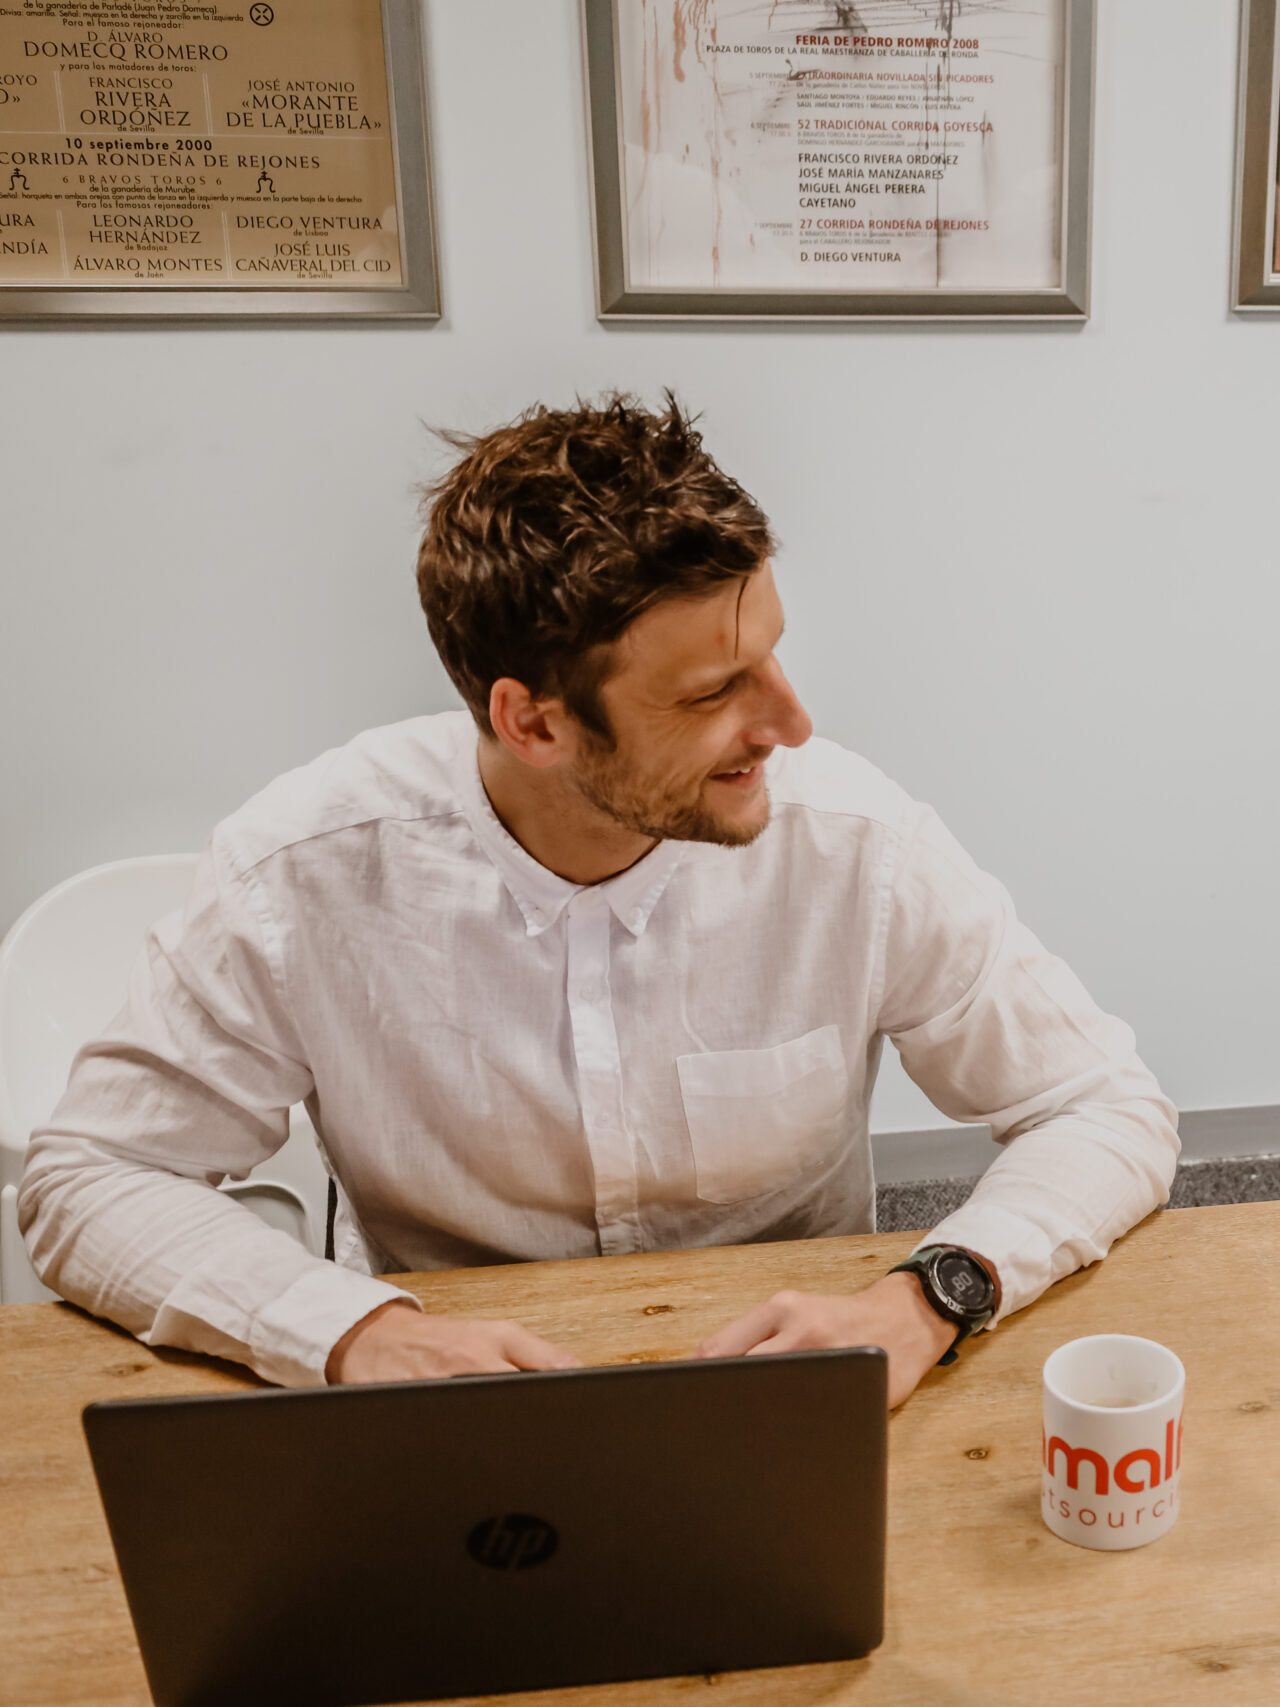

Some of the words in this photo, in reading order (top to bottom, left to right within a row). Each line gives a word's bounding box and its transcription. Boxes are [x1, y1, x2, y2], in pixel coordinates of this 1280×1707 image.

[23, 1, 33, 9] de
[36, 1, 43, 9] la
[90, 2, 100, 10] de
[158, 3, 180, 12] Pedro
[62, 18, 83, 27] Para
[87, 18, 95, 27] el
[98, 19, 130, 28] famoso
[108, 29, 163, 43] ÁLVARO
[796, 35, 830, 46] FERIA
[834, 35, 850, 47] DE
[853, 36, 893, 48] PEDRO
[897, 37, 949, 49] ROMERO
[952, 38, 980, 49] 2008
[24, 41, 128, 61] DOMECQ
[135, 43, 228, 61] ROMERO
[706, 45, 732, 54] PLAZA
[734, 45, 744, 54] DE
[746, 45, 772, 54] TOROS
[774, 46, 785, 55] DE
[787, 46, 798, 55] LA
[800, 47, 820, 55] REAL
[822, 47, 875, 56] MAESTRANZA
[877, 48, 887, 57] DE
[951, 49, 979, 59] RONDA
[60, 63, 65, 71] y
[93, 62, 105, 70] los
[109, 62, 155, 71] matadores
[158, 62, 169, 71] de
[0, 74, 37, 87] OYO
[89, 76, 173, 89] FRANCISCO
[876, 72, 926, 82] NOVILLADA
[946, 74, 994, 84] PICADORES
[247, 78, 281, 93] JOSÉ
[286, 80, 355, 93] ANTONIO
[95, 91, 172, 108] RIVERA
[242, 94, 359, 112] «MORANTE
[80, 106, 191, 126] ORDÓÑEZ
[226, 111, 254, 128] DE
[262, 112, 287, 128] LA
[295, 113, 382, 130] PUEBLA»
[118, 125, 127, 133] de
[129, 124, 155, 133] Sevilla
[287, 127, 296, 135] de
[299, 127, 324, 136] Sevilla
[798, 119, 810, 130] 52
[814, 119, 888, 131] TRADICIONAL
[892, 120, 939, 132] CORRIDA
[943, 121, 994, 132] GOYESCA
[65, 137, 83, 149] 10
[90, 138, 169, 153] septiembre
[176, 139, 213, 151] 2000
[0, 152, 88, 166] CORRIDA
[97, 151, 195, 167] RONDEÑA
[203, 154, 229, 168] DE
[238, 155, 320, 170] REJONES
[798, 153, 860, 164] FRANCISCO
[864, 154, 903, 165] RIVERA
[798, 167, 824, 179] JOSÉ
[828, 167, 865, 179] MARÍA
[868, 169, 944, 180] MANZANARES
[62, 175, 69, 184] 6
[79, 175, 141, 185] BRAVOS
[151, 175, 206, 186] TOROS
[216, 177, 222, 186] 6
[89, 185, 99, 193] de
[101, 184, 109, 193] la
[153, 185, 163, 193] de
[799, 182, 841, 194] MIGUEL
[845, 181, 881, 194] ÁNGEL
[885, 183, 926, 195] PERERA
[76, 200, 97, 209] Para
[100, 200, 112, 209] los
[116, 200, 151, 210] famosos
[799, 197, 856, 208] CAYETANO
[93, 214, 194, 229] LEONARDO
[236, 216, 293, 229] DIEGO
[300, 216, 382, 230] VENTURA
[800, 218, 812, 230] 27
[816, 219, 865, 230] CORRIDA
[869, 218, 922, 230] RONDEÑA
[925, 219, 939, 231] DE
[943, 219, 990, 231] REJONES
[89, 228, 201, 244] HERNÁNDEZ
[293, 229, 302, 237] de
[0, 238, 49, 255] NDÍA
[125, 243, 134, 251] de
[137, 243, 168, 252] Badajoz
[274, 240, 310, 258] JOSÉ
[316, 243, 351, 257] LUIS
[74, 255, 140, 271] ÁLVARO
[148, 258, 223, 272] MONTES
[814, 252, 848, 263] DIEGO
[851, 252, 902, 263] VENTURA
[236, 256, 328, 272] CAÑAVERAL
[331, 259, 360, 272] DEL
[363, 259, 391, 273] CID
[308, 270, 333, 279] Sevilla
